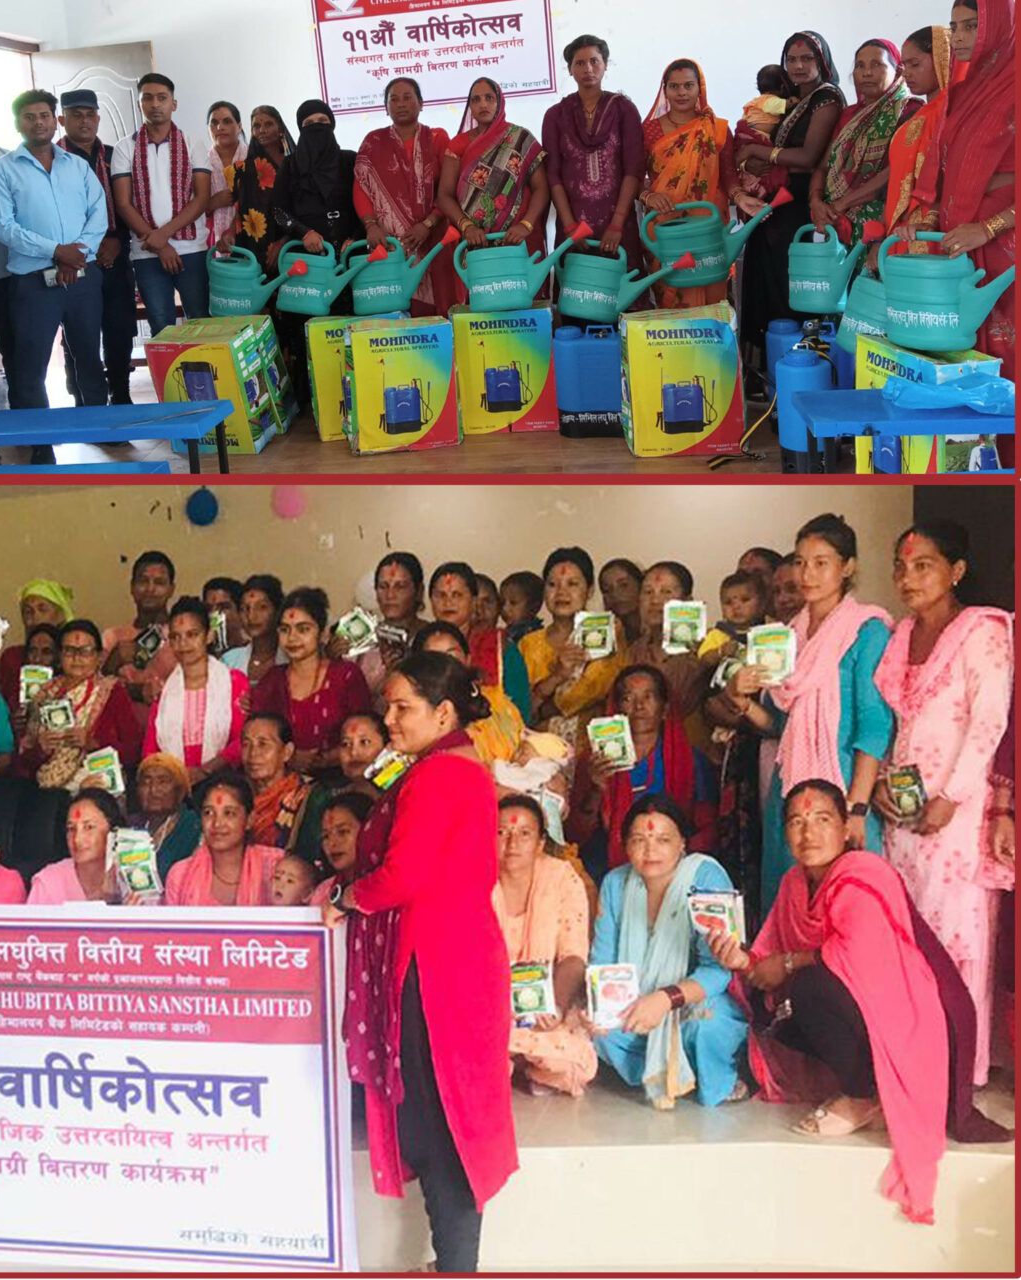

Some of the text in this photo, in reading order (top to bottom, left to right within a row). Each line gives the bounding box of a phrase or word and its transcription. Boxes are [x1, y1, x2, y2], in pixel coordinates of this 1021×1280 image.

[405, 13, 523, 43] वार्षिकोत्सव
[346, 37, 524, 65] संस्थागत सामाजिक उत्तरदायित्व अन्तर्गत
[394, 63, 423, 75] सामग्री
[469, 318, 537, 330] MOHINDRA
[646, 329, 723, 340] MOHINDRA
[369, 334, 439, 348] MOHINDRA
[77, 936, 143, 964] वित्तीय
[154, 940, 211, 967] संस्था
[222, 939, 311, 970] लिमिटेड
[77, 994, 145, 1016] BITTIYA
[148, 996, 230, 1017] SANSTHA
[231, 997, 313, 1019] LIMITED
[56, 1123, 174, 1148] उत्तरदायित्व
[187, 1128, 270, 1154] अन्तर्गत
